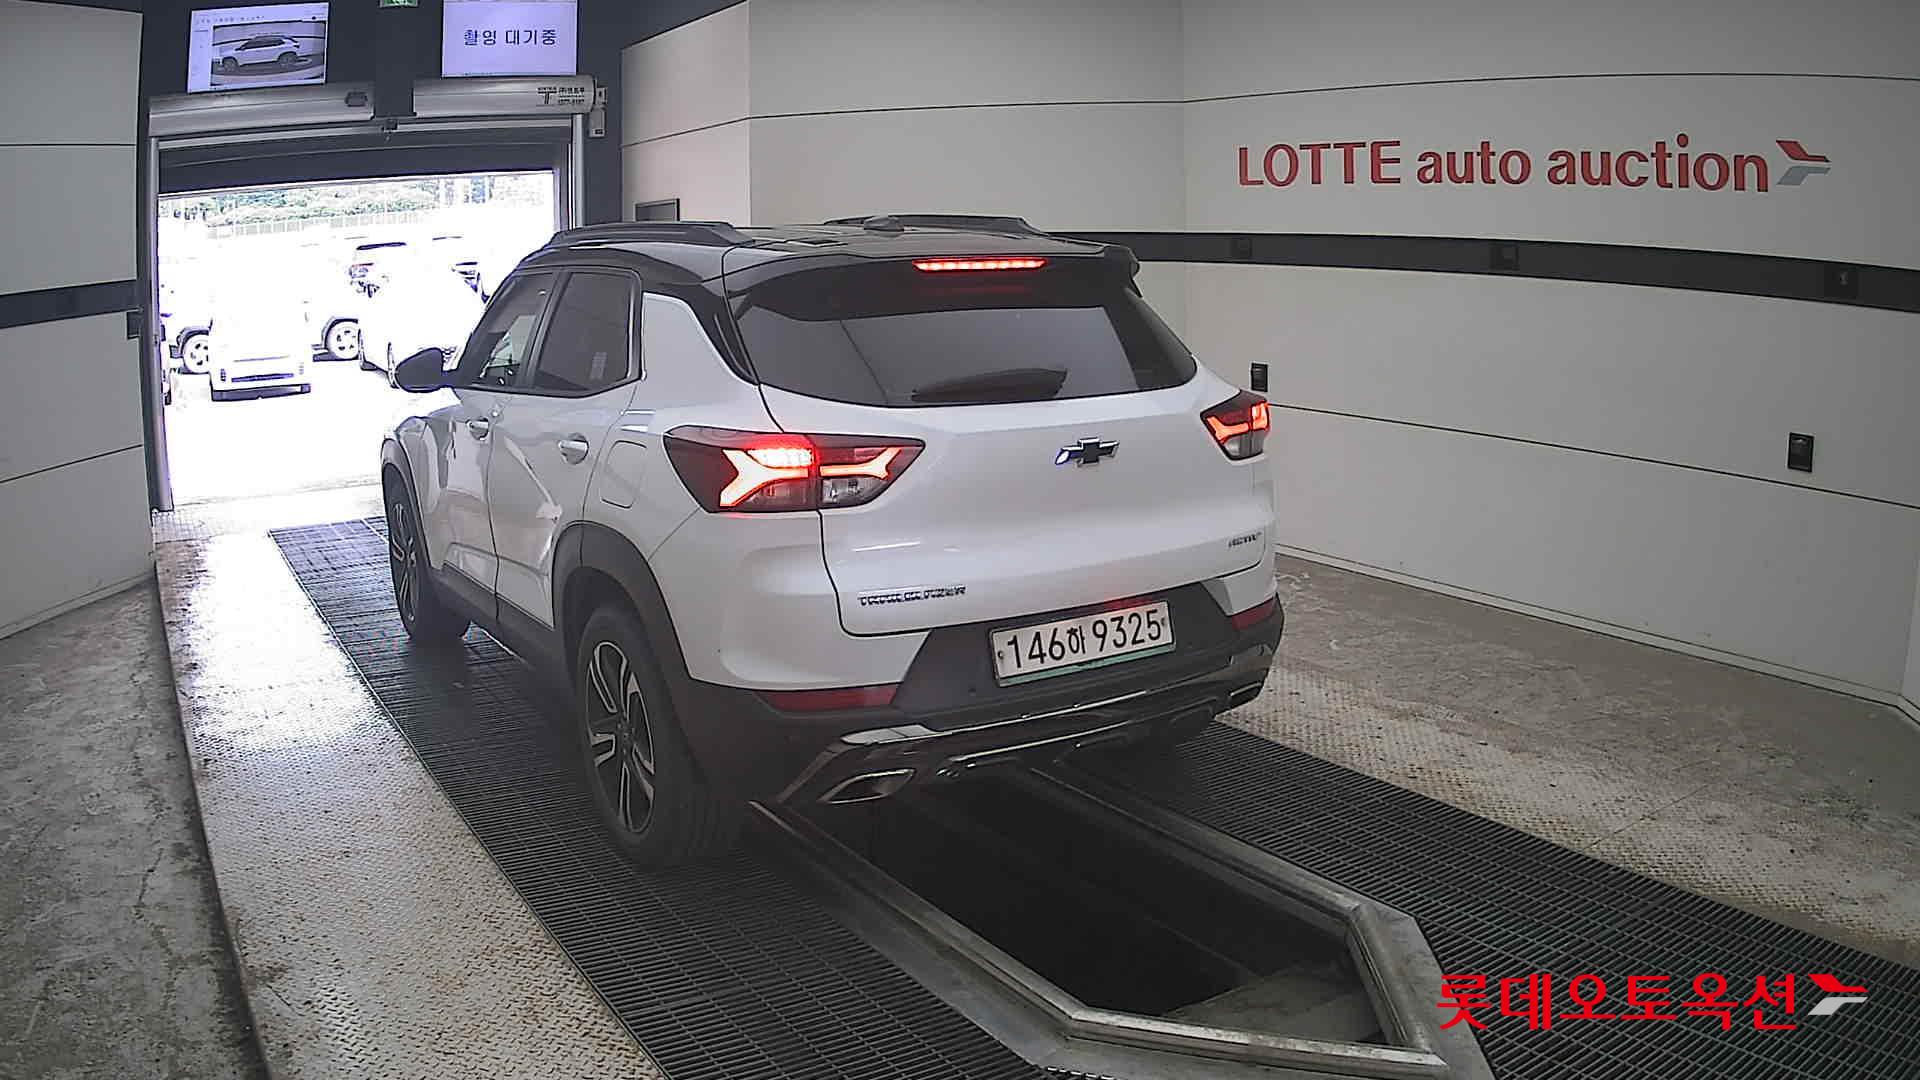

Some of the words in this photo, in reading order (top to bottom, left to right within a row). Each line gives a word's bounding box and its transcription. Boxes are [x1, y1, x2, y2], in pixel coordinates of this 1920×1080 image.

[505, 28, 557, 46] 대기중
[1239, 140, 1401, 187] LOTTE
[1416, 141, 1532, 185] auto
[1547, 133, 1770, 192] auction
[1092, 608, 1161, 652] 9325
